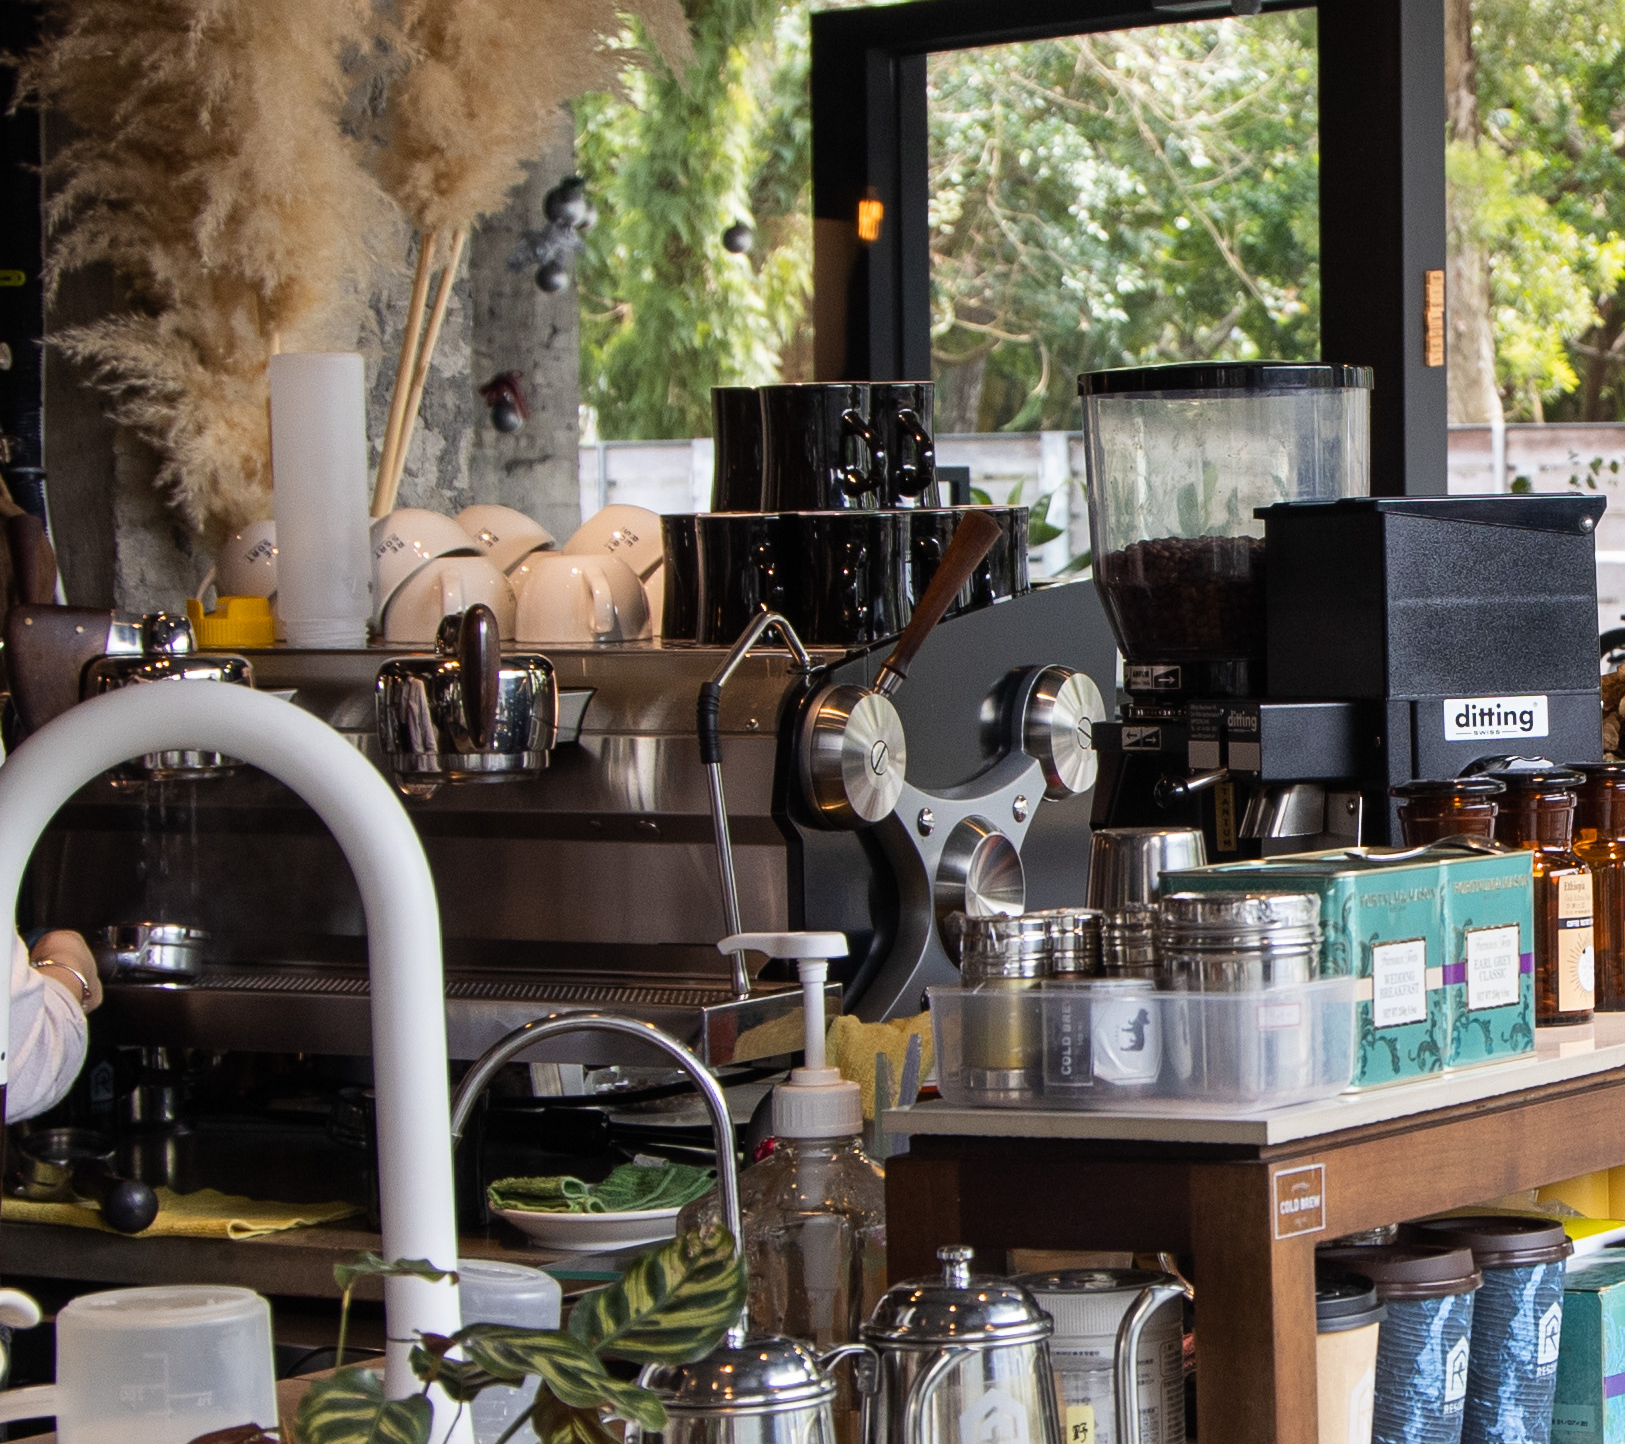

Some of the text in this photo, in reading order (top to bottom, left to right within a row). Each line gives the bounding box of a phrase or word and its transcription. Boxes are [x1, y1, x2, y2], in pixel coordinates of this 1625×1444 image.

[1227, 710, 1257, 732] ditting
[1455, 703, 1534, 732] ditting
[1279, 1199, 1299, 1215] COLD
